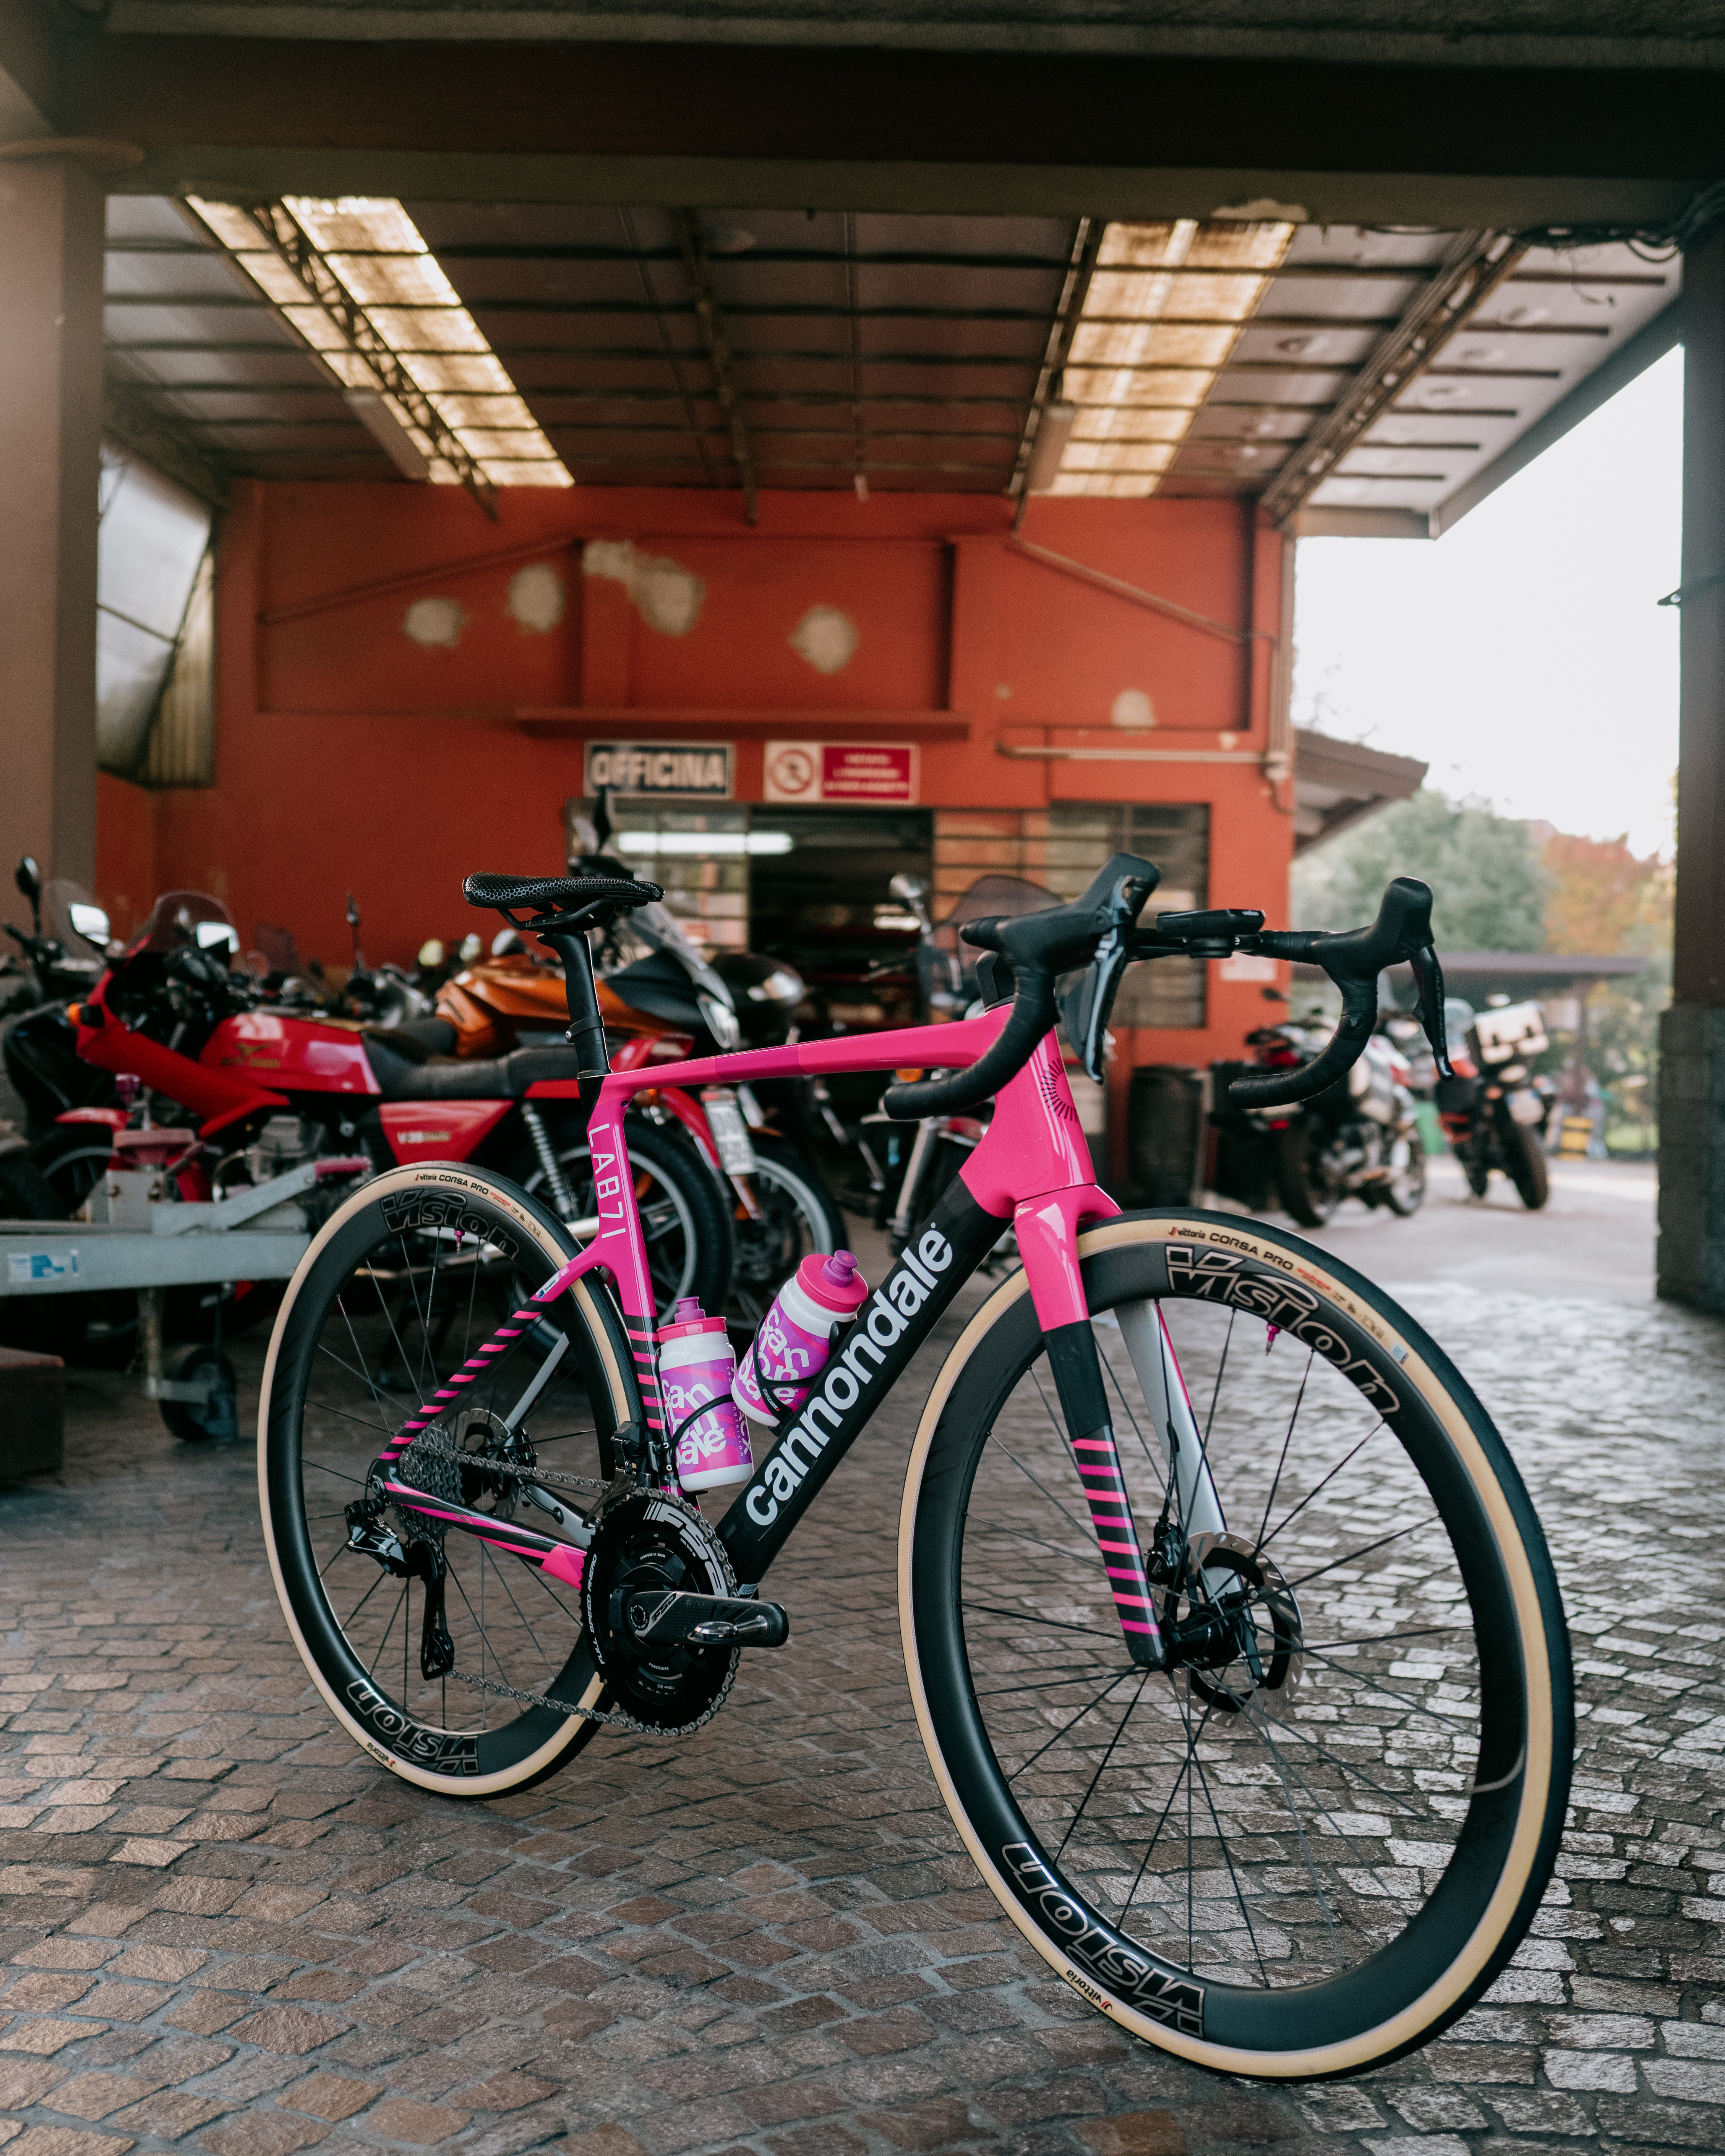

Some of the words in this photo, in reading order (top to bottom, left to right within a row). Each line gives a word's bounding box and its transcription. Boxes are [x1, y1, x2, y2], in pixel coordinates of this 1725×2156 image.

[591, 751, 726, 788] OFFICINA
[439, 1175, 468, 1187] CORSA
[470, 1182, 488, 1194] PRO
[589, 1123, 626, 1239] LAB71
[1177, 1228, 1205, 1239] vittoria
[1210, 1233, 1258, 1255] CORSA
[1264, 1251, 1294, 1270] PRO
[545, 1280, 556, 1291] Sweeny
[561, 1268, 567, 1276] EF
[766, 1308, 809, 1369] can
[747, 1230, 953, 1526] cannondale
[661, 1379, 715, 1410] can
[762, 1388, 778, 1409] LEGGEROCARBON
[587, 1553, 597, 1592] AHEAD
[593, 1637, 605, 1664] FULL
[649, 1662, 669, 1670] POWER2MAX
[1066, 1970, 1102, 2002] vittoria
